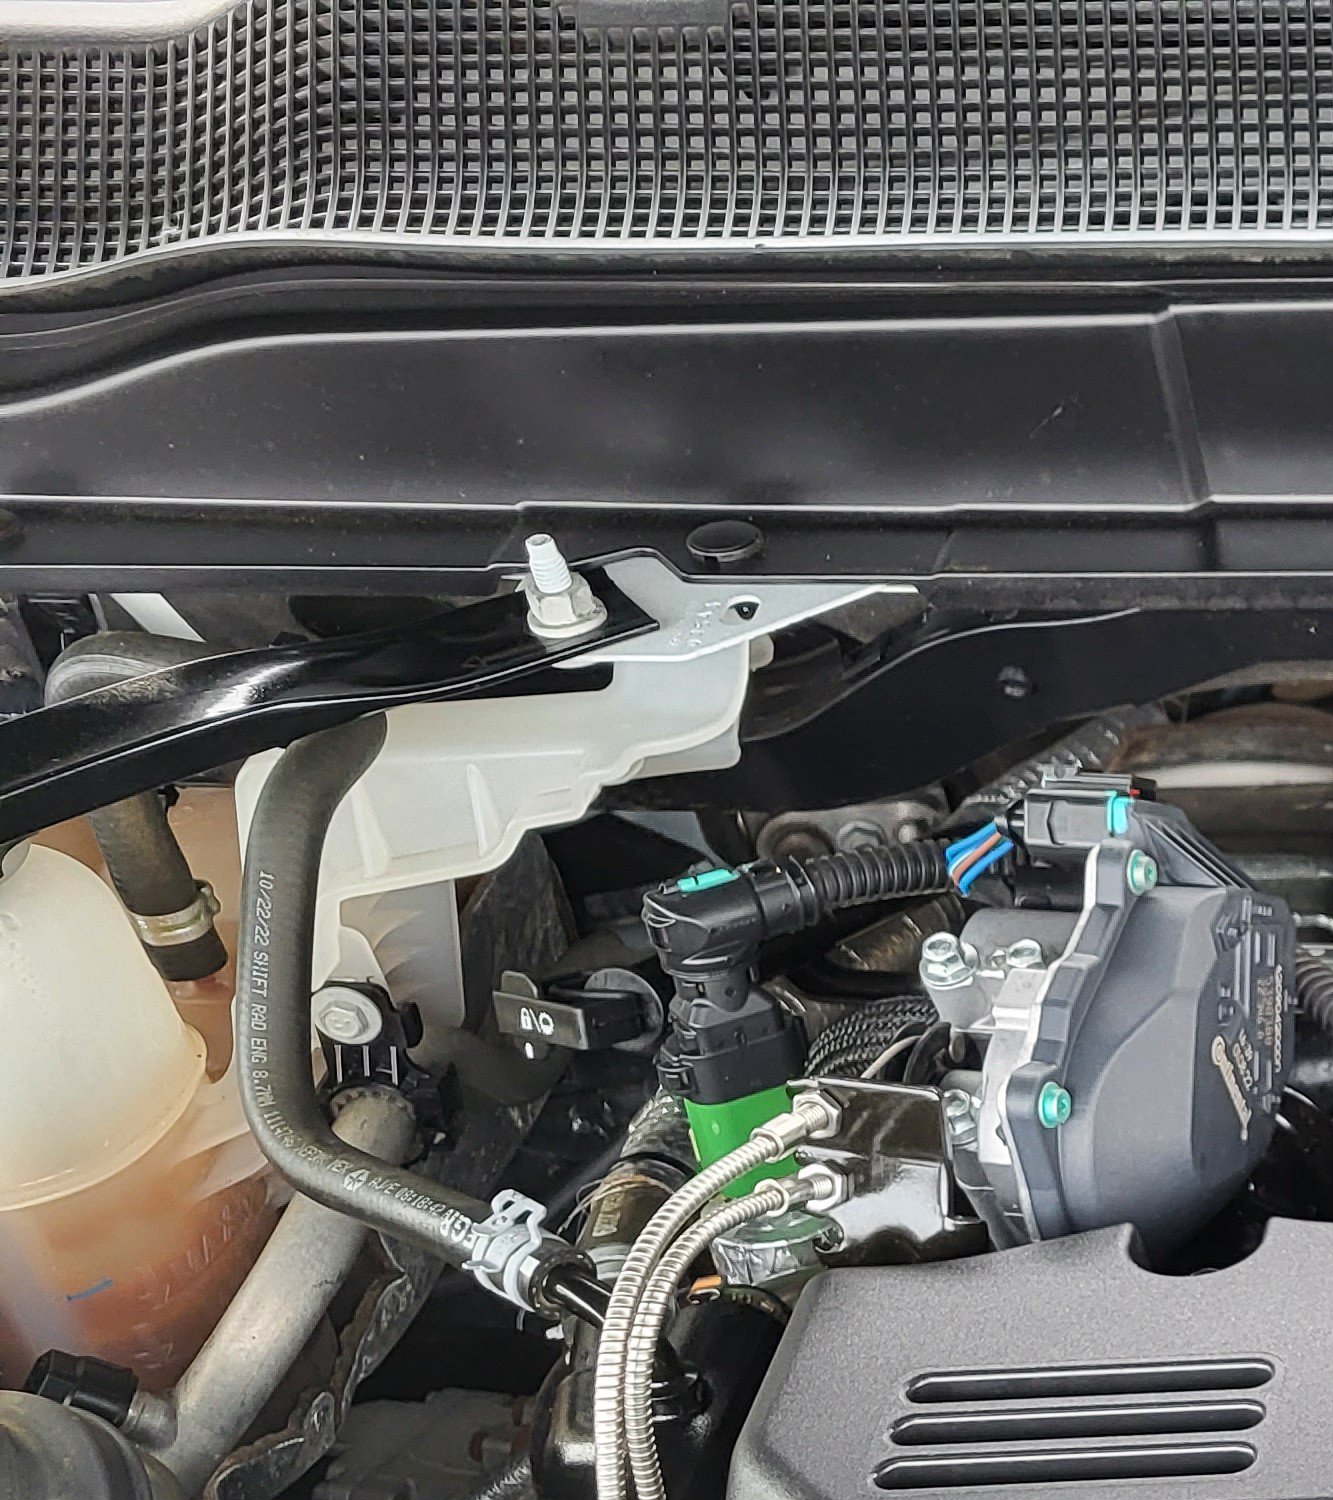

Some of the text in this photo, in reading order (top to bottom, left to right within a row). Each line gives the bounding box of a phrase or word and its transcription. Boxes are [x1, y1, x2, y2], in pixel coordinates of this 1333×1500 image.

[254, 870, 275, 947] 10/22/22
[251, 950, 269, 998] SHIFT
[251, 1003, 268, 1031] RAD
[251, 1037, 268, 1063] ENG
